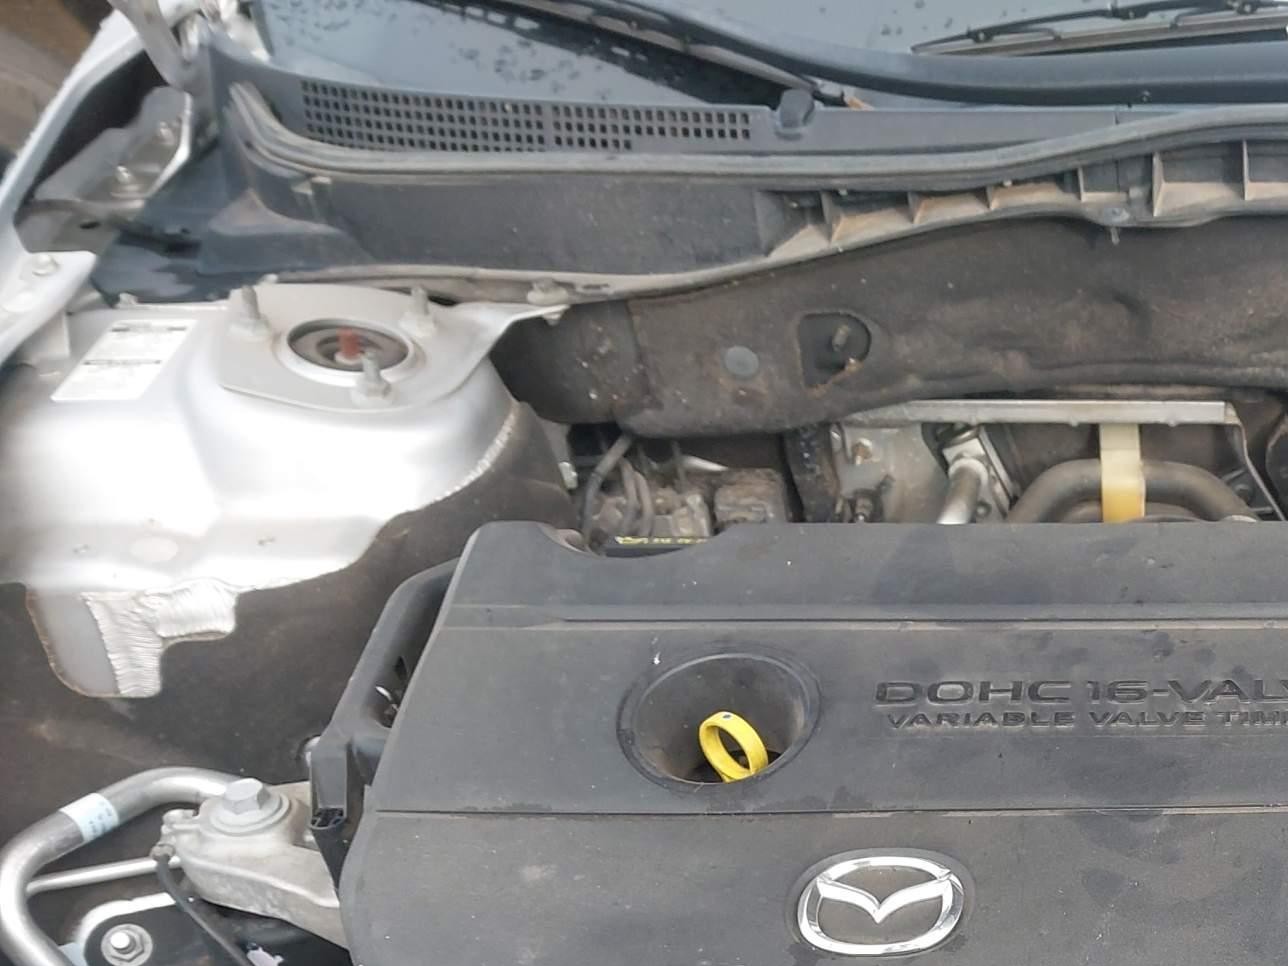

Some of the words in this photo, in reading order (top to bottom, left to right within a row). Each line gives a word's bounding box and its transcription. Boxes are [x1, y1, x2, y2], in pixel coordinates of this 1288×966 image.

[875, 680, 1071, 705] DOHC
[887, 711, 1076, 729] VARIABLE
[1089, 711, 1207, 728] VALVE
